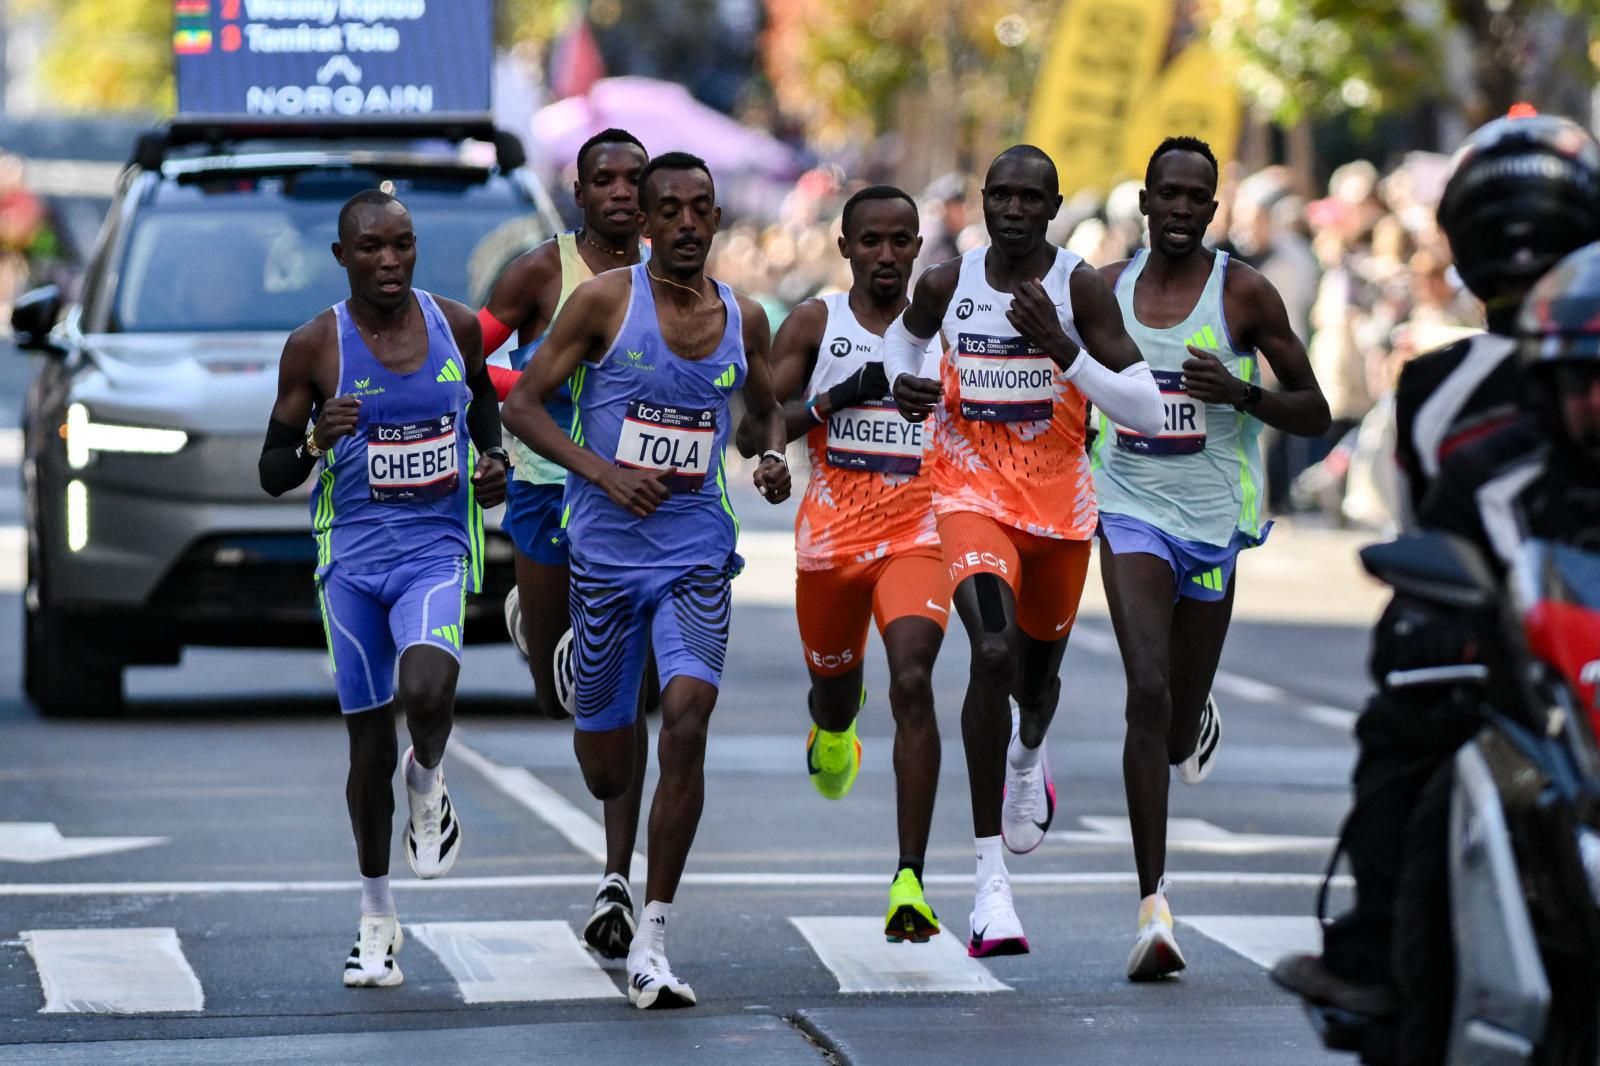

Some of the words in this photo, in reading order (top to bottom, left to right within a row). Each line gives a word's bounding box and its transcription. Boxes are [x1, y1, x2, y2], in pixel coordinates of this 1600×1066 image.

[245, 22, 344, 53] Tamirat
[343, 22, 400, 52] Tola
[977, 304, 992, 312] NN
[855, 344, 871, 353] NN
[960, 367, 1053, 389] KAMWOROR
[637, 403, 661, 422] tcs
[378, 426, 401, 441] tcs
[828, 416, 923, 446] NAGEEYE
[370, 442, 456, 480] CHEBET
[639, 432, 699, 469] TOLA
[949, 551, 1008, 581] INEOS
